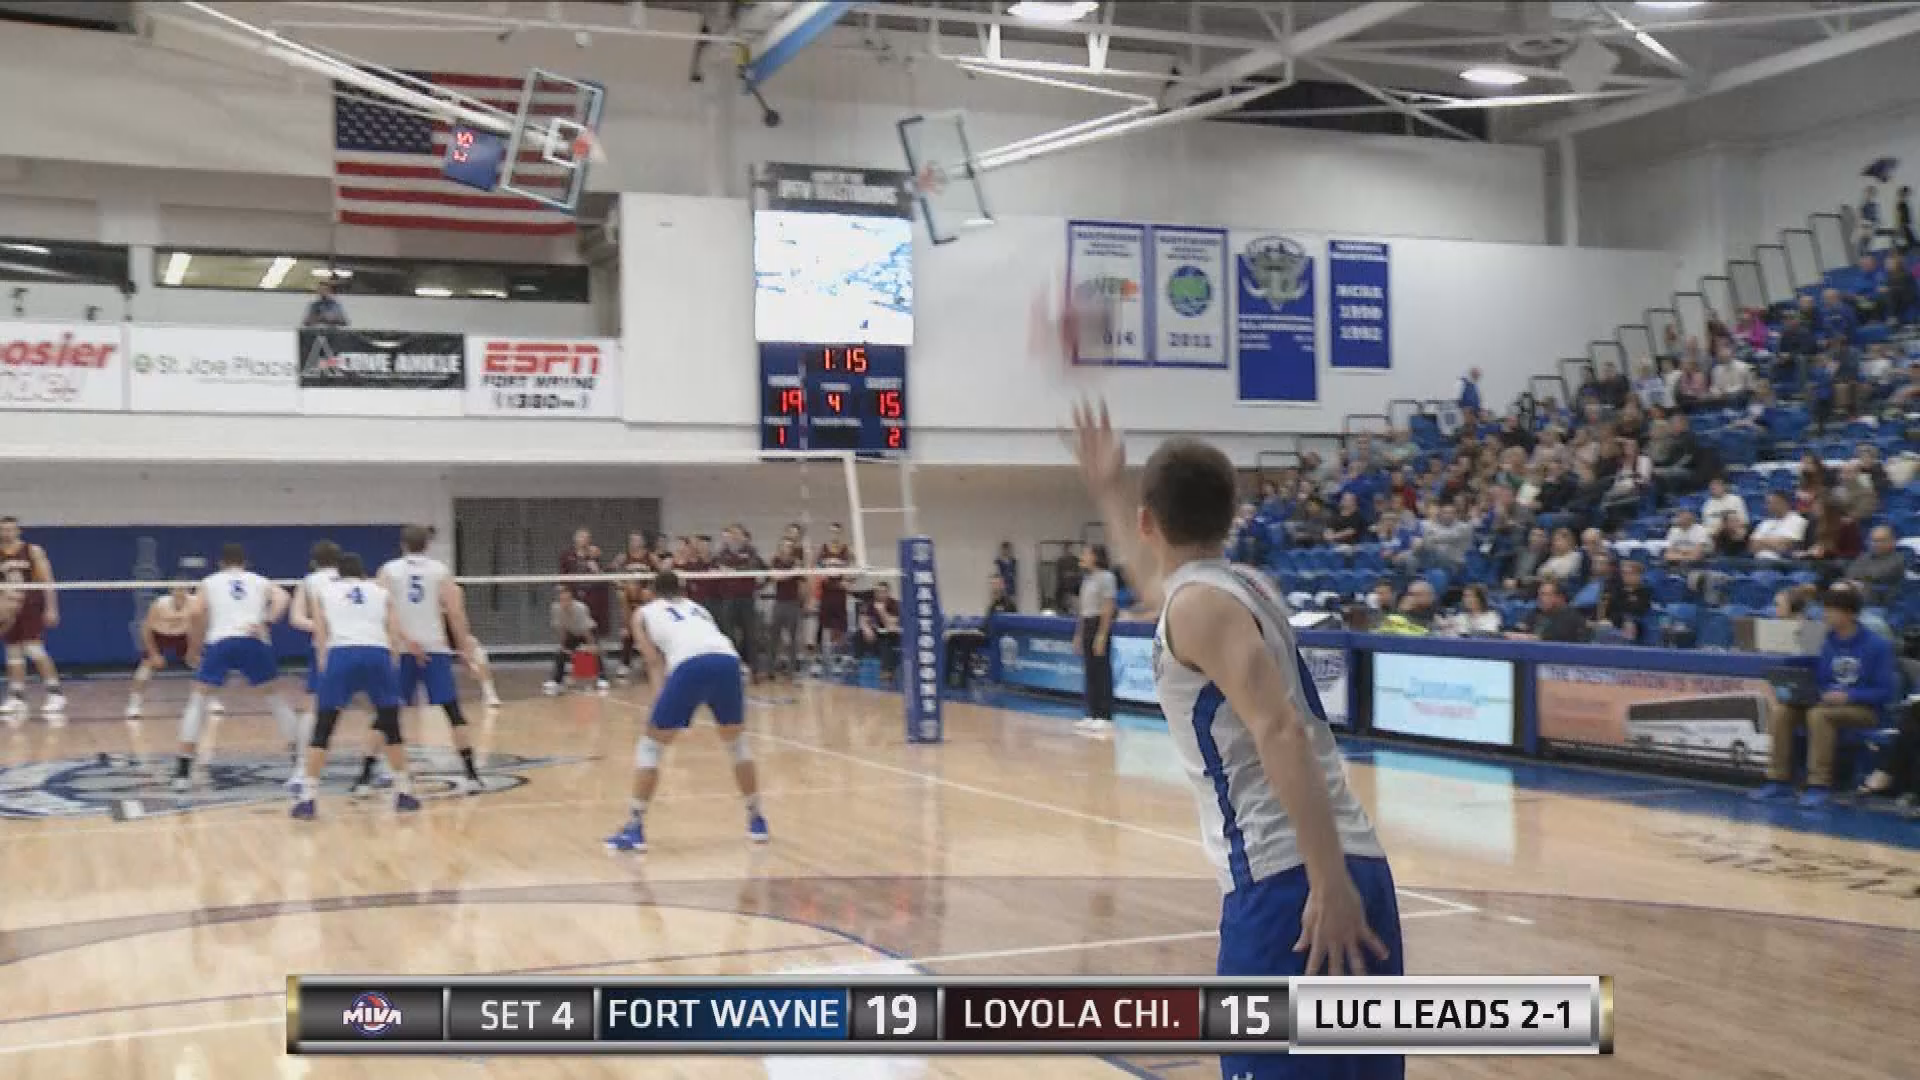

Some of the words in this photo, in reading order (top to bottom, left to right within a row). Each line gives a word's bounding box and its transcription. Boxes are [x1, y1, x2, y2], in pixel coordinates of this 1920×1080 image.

[482, 341, 600, 374] ESPN
[781, 389, 803, 413] 19
[828, 393, 841, 412] 4
[880, 391, 901, 417] 15
[889, 427, 901, 448] 2
[347, 586, 365, 605] 4
[407, 574, 424, 604] 5
